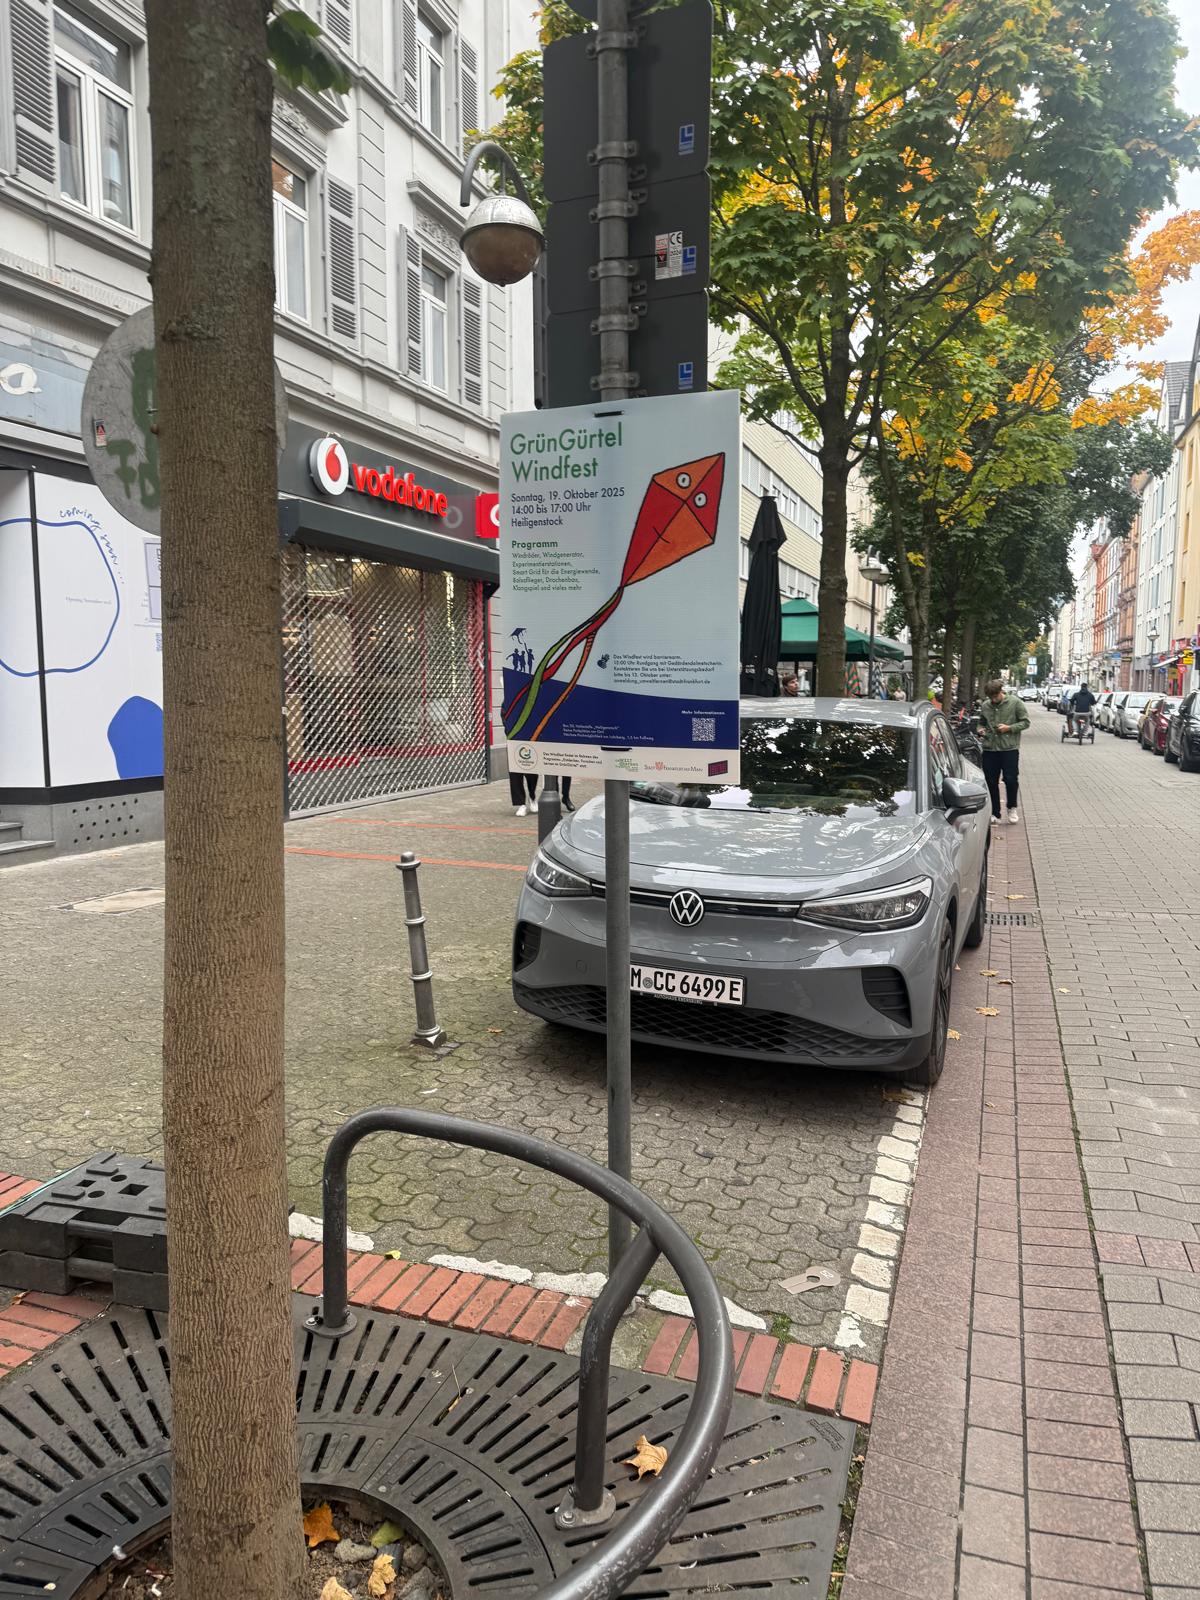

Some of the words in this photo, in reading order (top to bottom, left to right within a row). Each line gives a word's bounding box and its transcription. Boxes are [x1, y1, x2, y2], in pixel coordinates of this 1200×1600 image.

[510, 421, 622, 455] GrünGürtel
[511, 454, 599, 483] Windfest
[352, 463, 449, 518] vodafone
[511, 492, 546, 504] Sonntag,
[549, 490, 561, 501] 19.
[563, 488, 599, 500] Oktober
[601, 486, 625, 498] 2025
[511, 504, 534, 515] 14:00
[536, 503, 548, 514] bis
[550, 502, 573, 513] 17:00
[575, 501, 592, 512] Uhr
[511, 515, 564, 529] Heiligenstock
[511, 540, 559, 550] Programm
[630, 967, 642, 988] M
[653, 971, 676, 993] CC
